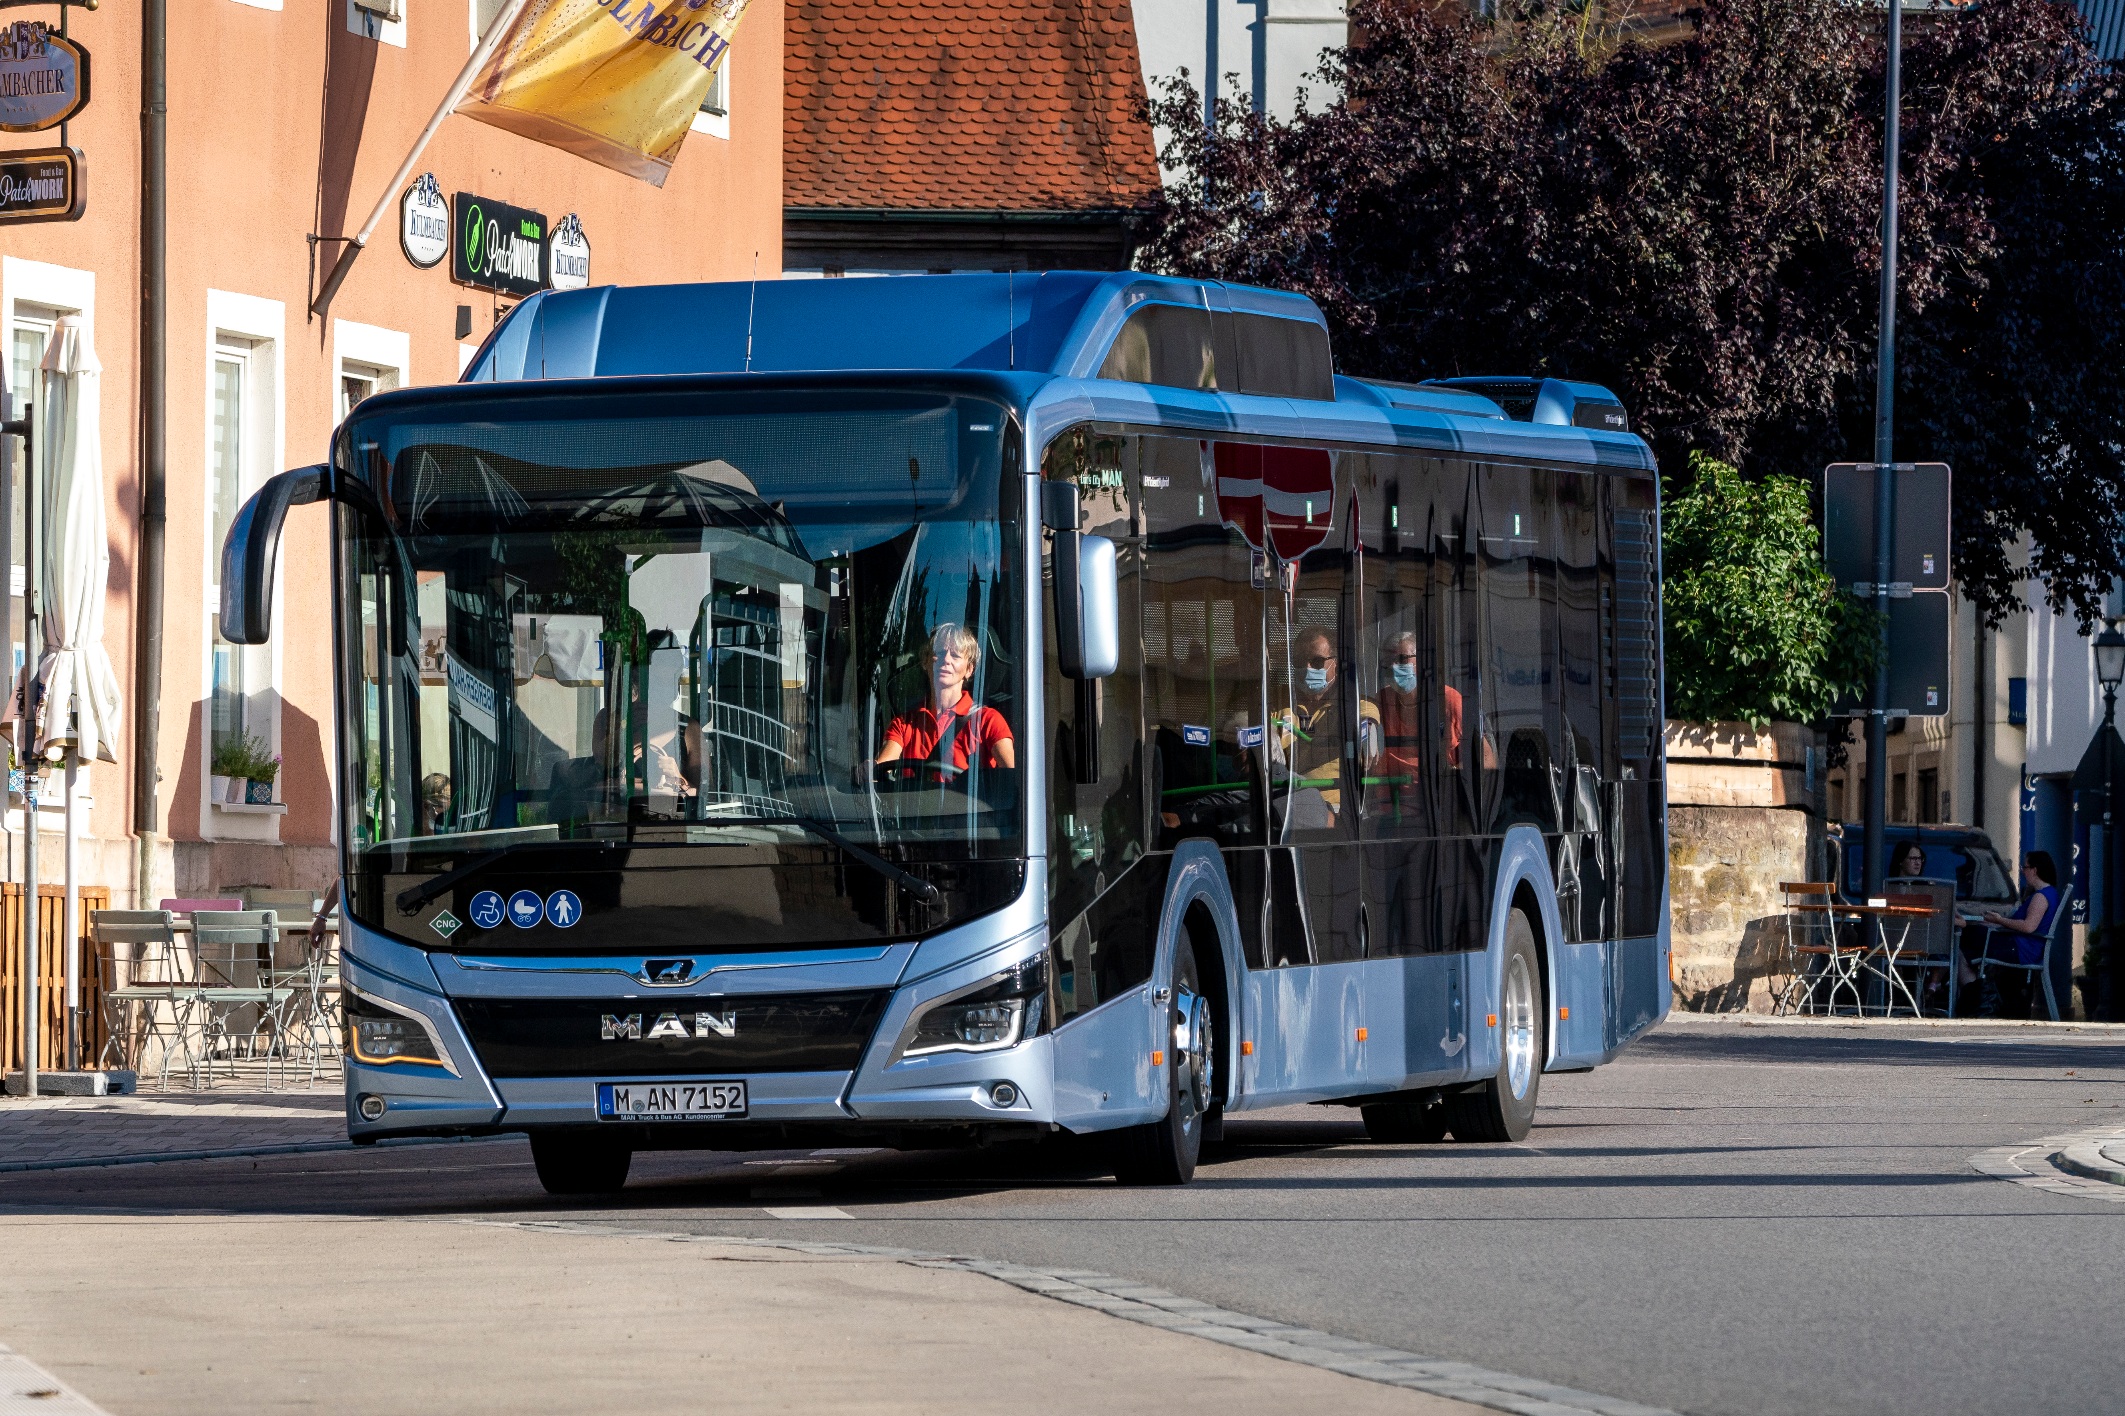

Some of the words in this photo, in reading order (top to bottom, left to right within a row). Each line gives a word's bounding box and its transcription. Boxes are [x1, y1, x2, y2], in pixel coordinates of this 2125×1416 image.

[0, 69, 66, 98] MBACHER
[1101, 469, 1123, 486] MAN
[436, 920, 456, 928] CNG
[601, 1011, 736, 1040] MAN
[615, 1089, 631, 1111] M
[648, 1088, 678, 1110] AN
[683, 1086, 743, 1110] 7152
